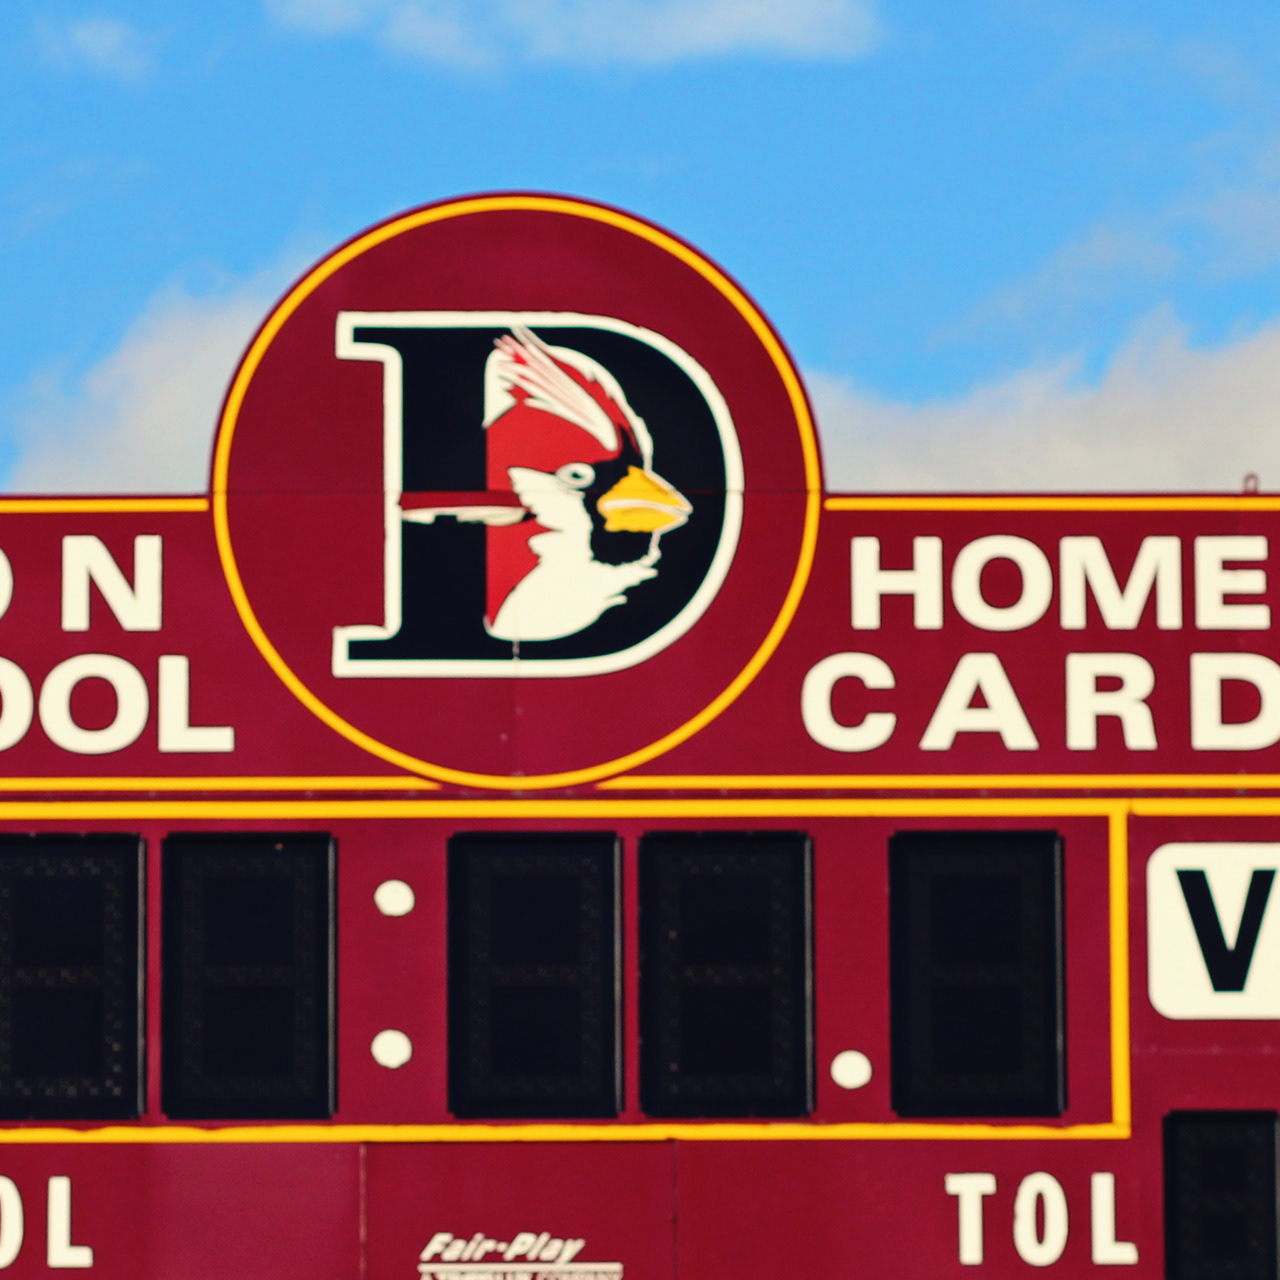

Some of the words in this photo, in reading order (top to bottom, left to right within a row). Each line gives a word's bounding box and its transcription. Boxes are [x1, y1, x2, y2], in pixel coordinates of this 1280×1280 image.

[850, 535, 1271, 631] HOME
[419, 1231, 586, 1266] Fair-Play
[945, 1172, 1138, 1267] TOL
